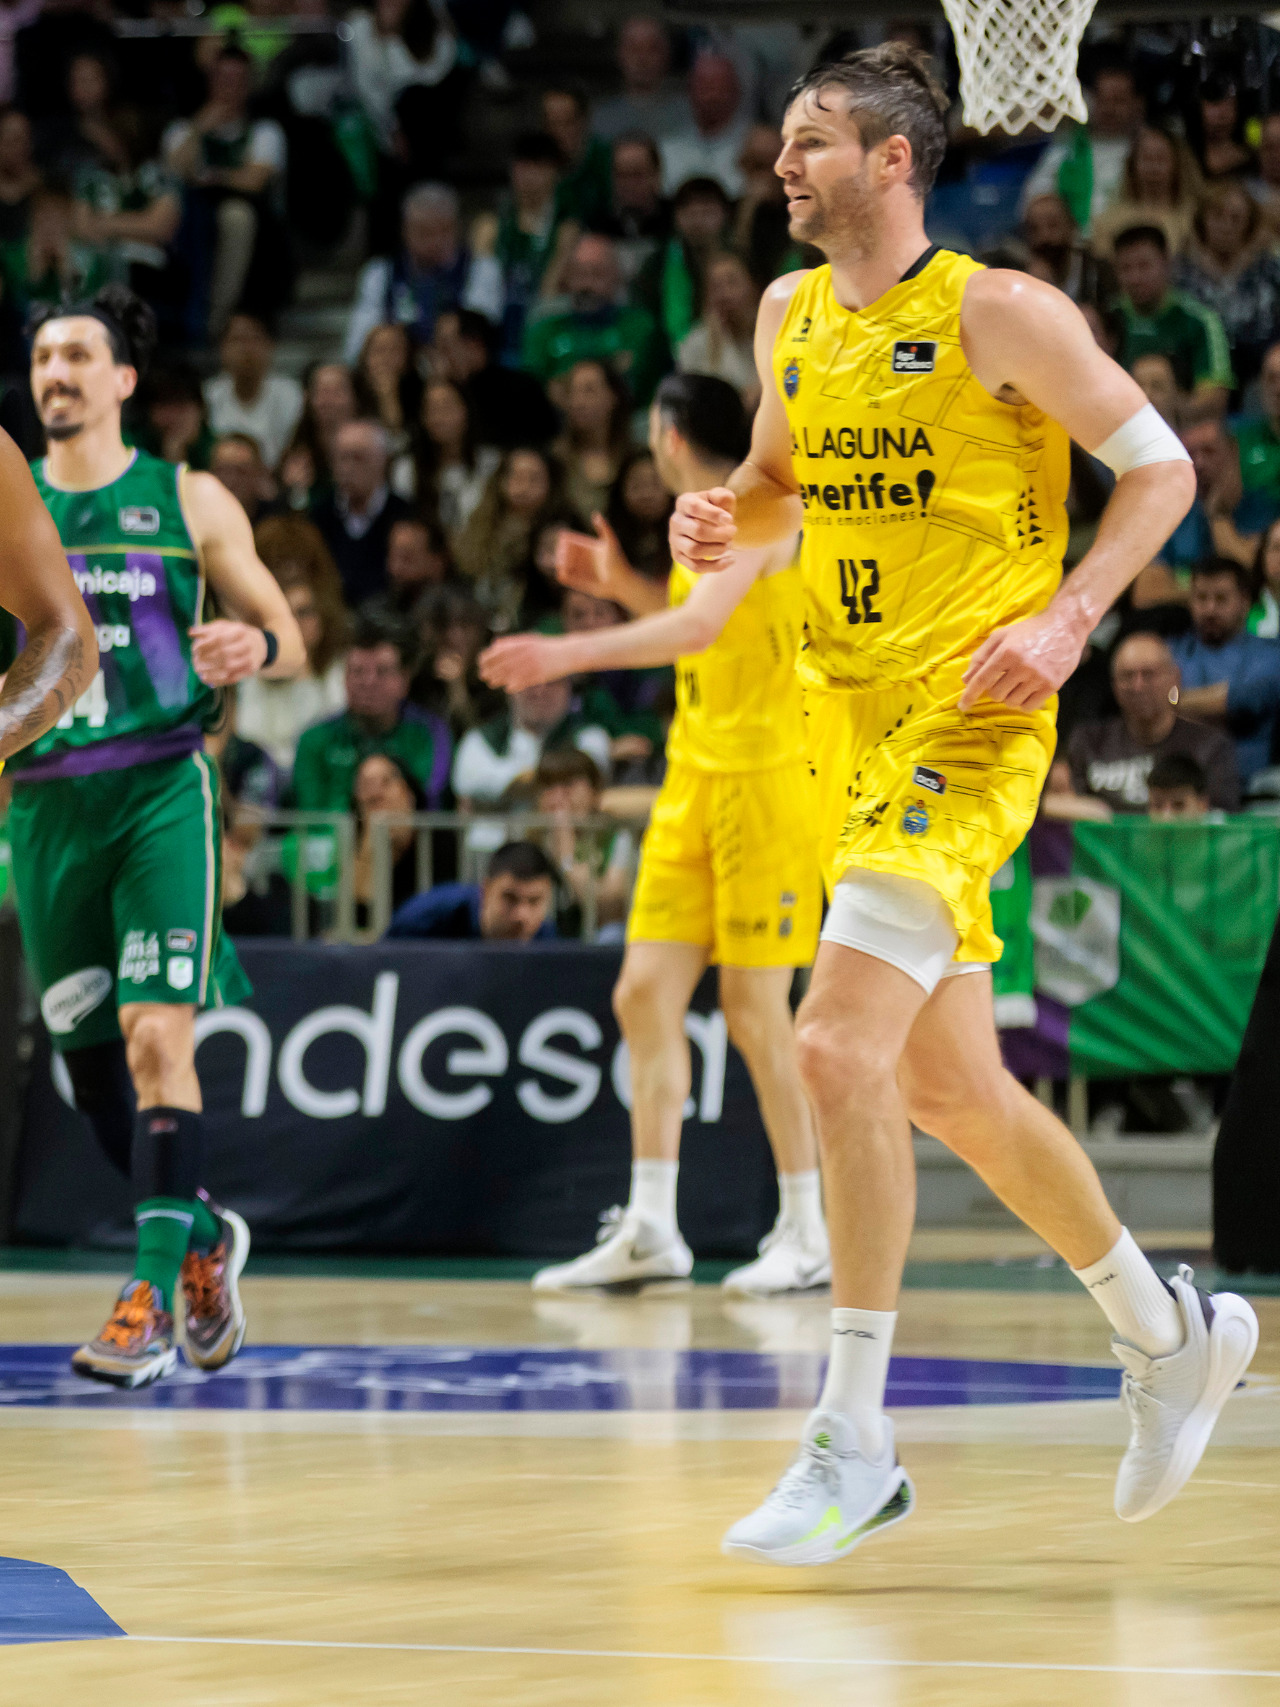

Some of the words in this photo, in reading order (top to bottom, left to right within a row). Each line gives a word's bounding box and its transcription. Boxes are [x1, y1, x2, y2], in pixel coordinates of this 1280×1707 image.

[804, 427, 935, 459] LAGUNA
[800, 469, 936, 518] enerife!
[73, 565, 156, 601] nicaja
[837, 559, 882, 625] 42
